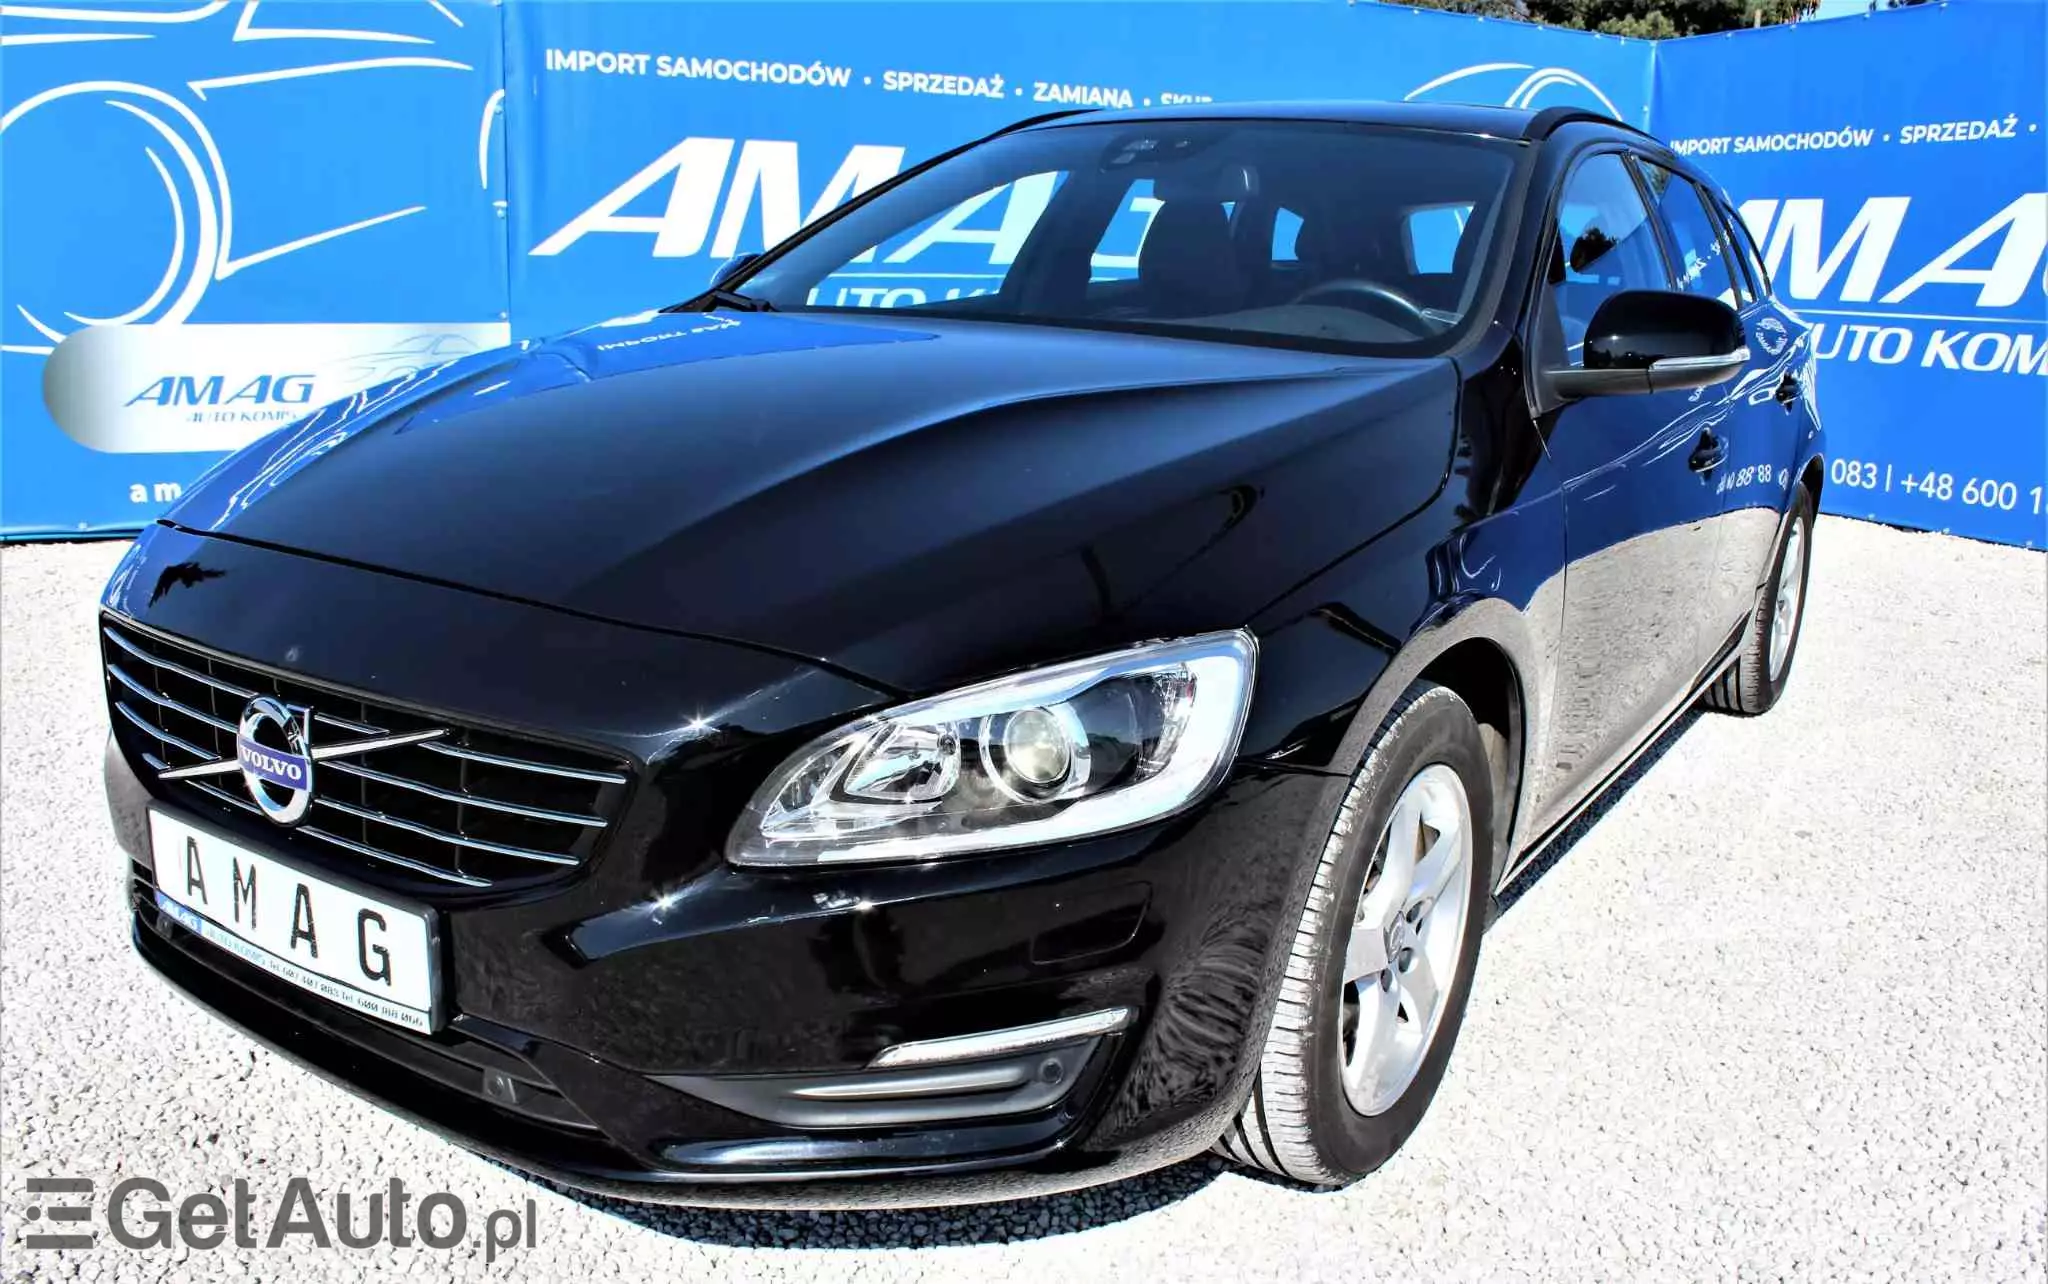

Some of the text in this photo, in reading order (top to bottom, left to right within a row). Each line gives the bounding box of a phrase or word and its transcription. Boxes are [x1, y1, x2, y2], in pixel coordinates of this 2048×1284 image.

[546, 49, 650, 75] IMPORT
[656, 56, 851, 87] SAMOCHODÓW
[883, 71, 1004, 99] SPRZEDAŻ
[1033, 82, 1133, 108] ZAMIANA
[1670, 113, 2018, 156] IMPORT SAMOCHODÓW SPRZEDAŻ
[1831, 458, 1878, 489] 083
[1901, 471, 1954, 501] +48
[1962, 478, 2017, 511] 600
[240, 746, 302, 780] VOLVO
